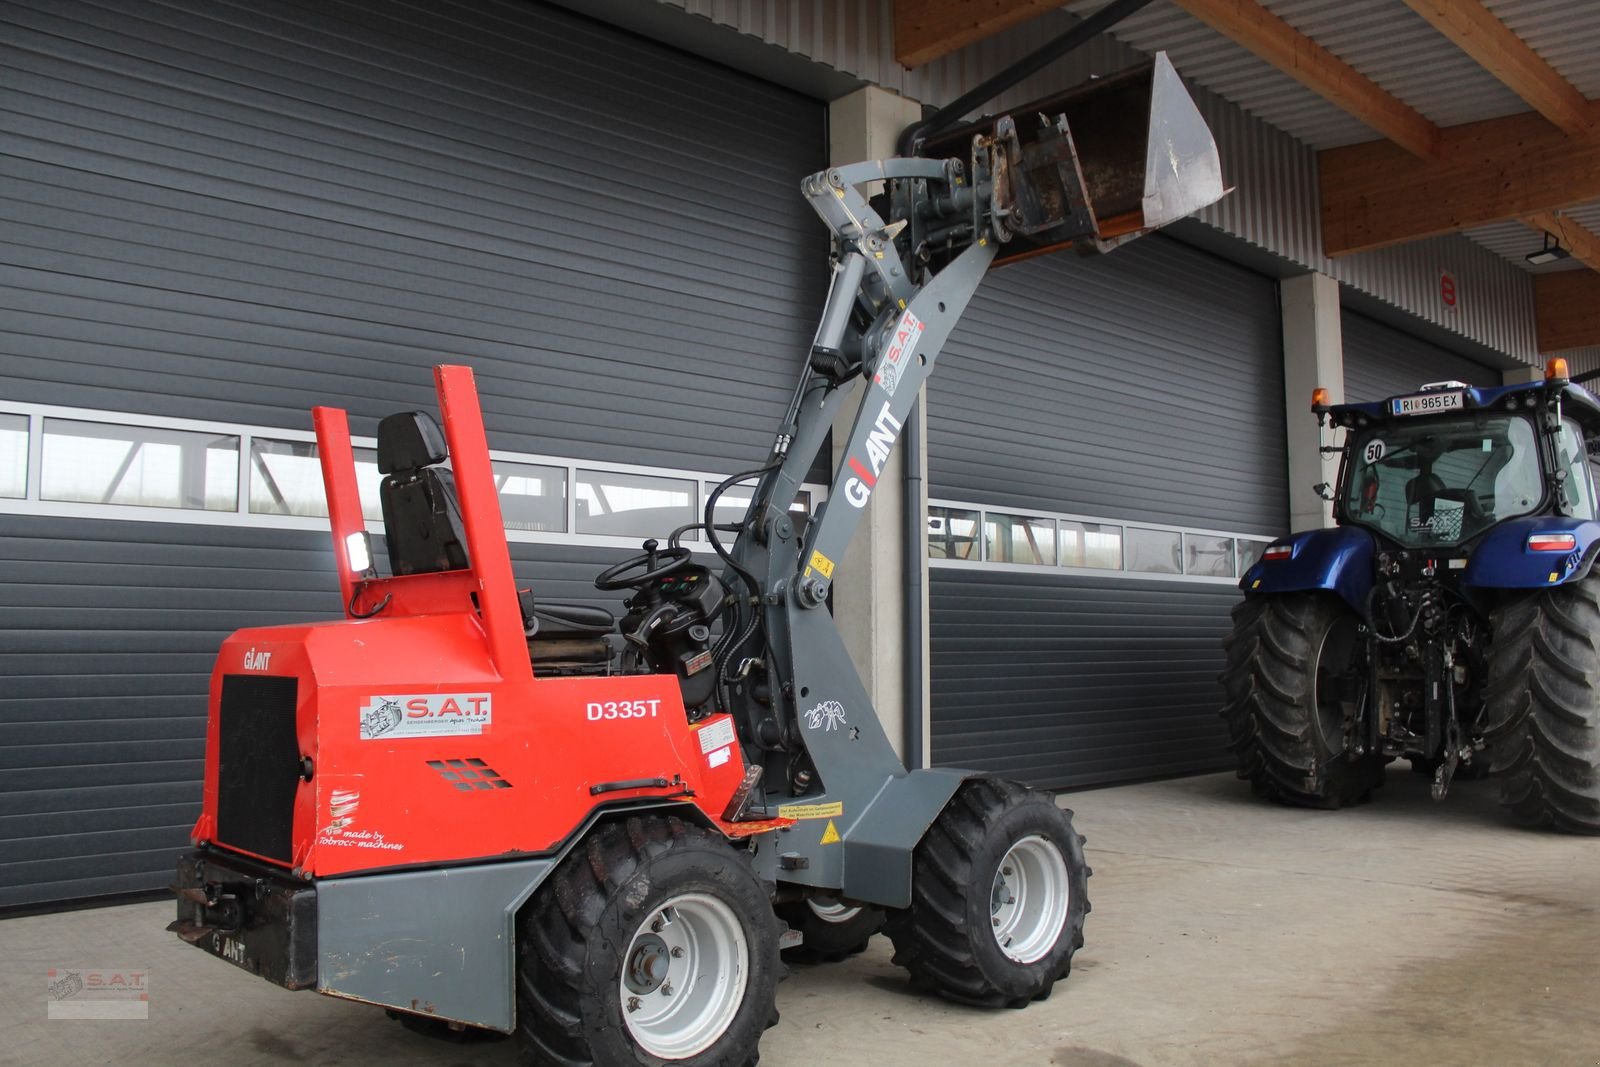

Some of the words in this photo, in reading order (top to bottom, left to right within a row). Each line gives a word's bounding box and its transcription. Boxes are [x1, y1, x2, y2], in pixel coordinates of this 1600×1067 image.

[1403, 400, 1414, 411] RI
[1421, 397, 1442, 409] 965
[1443, 395, 1457, 407] EX
[845, 400, 901, 508] GIANT
[1367, 444, 1382, 460] 50
[406, 697, 488, 718] S.A.T.
[586, 700, 661, 721] D335T
[343, 830, 372, 839] made
[373, 831, 384, 842] by
[358, 840, 404, 850] machines
